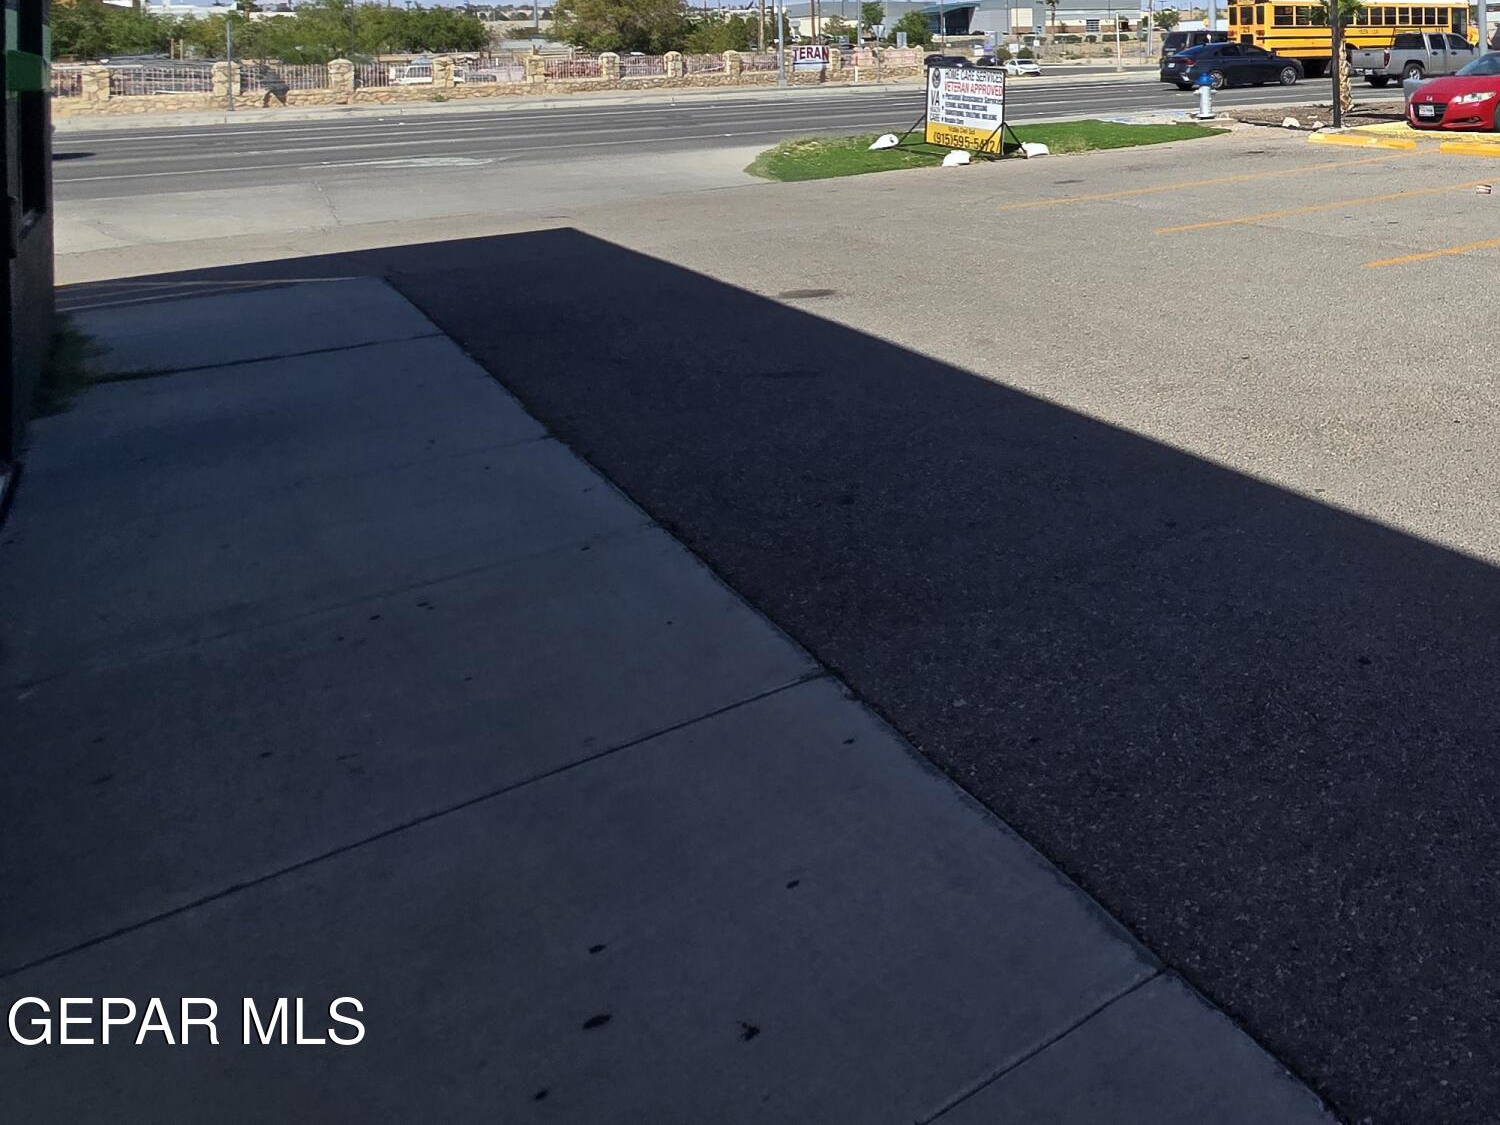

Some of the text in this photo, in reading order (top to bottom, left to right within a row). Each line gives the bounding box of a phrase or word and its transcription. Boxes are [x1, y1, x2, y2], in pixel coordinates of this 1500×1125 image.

[945, 70, 1003, 84] HOME CARE SERVICES
[944, 81, 1003, 97] VETERAN APPROVED
[930, 90, 940, 106] VA
